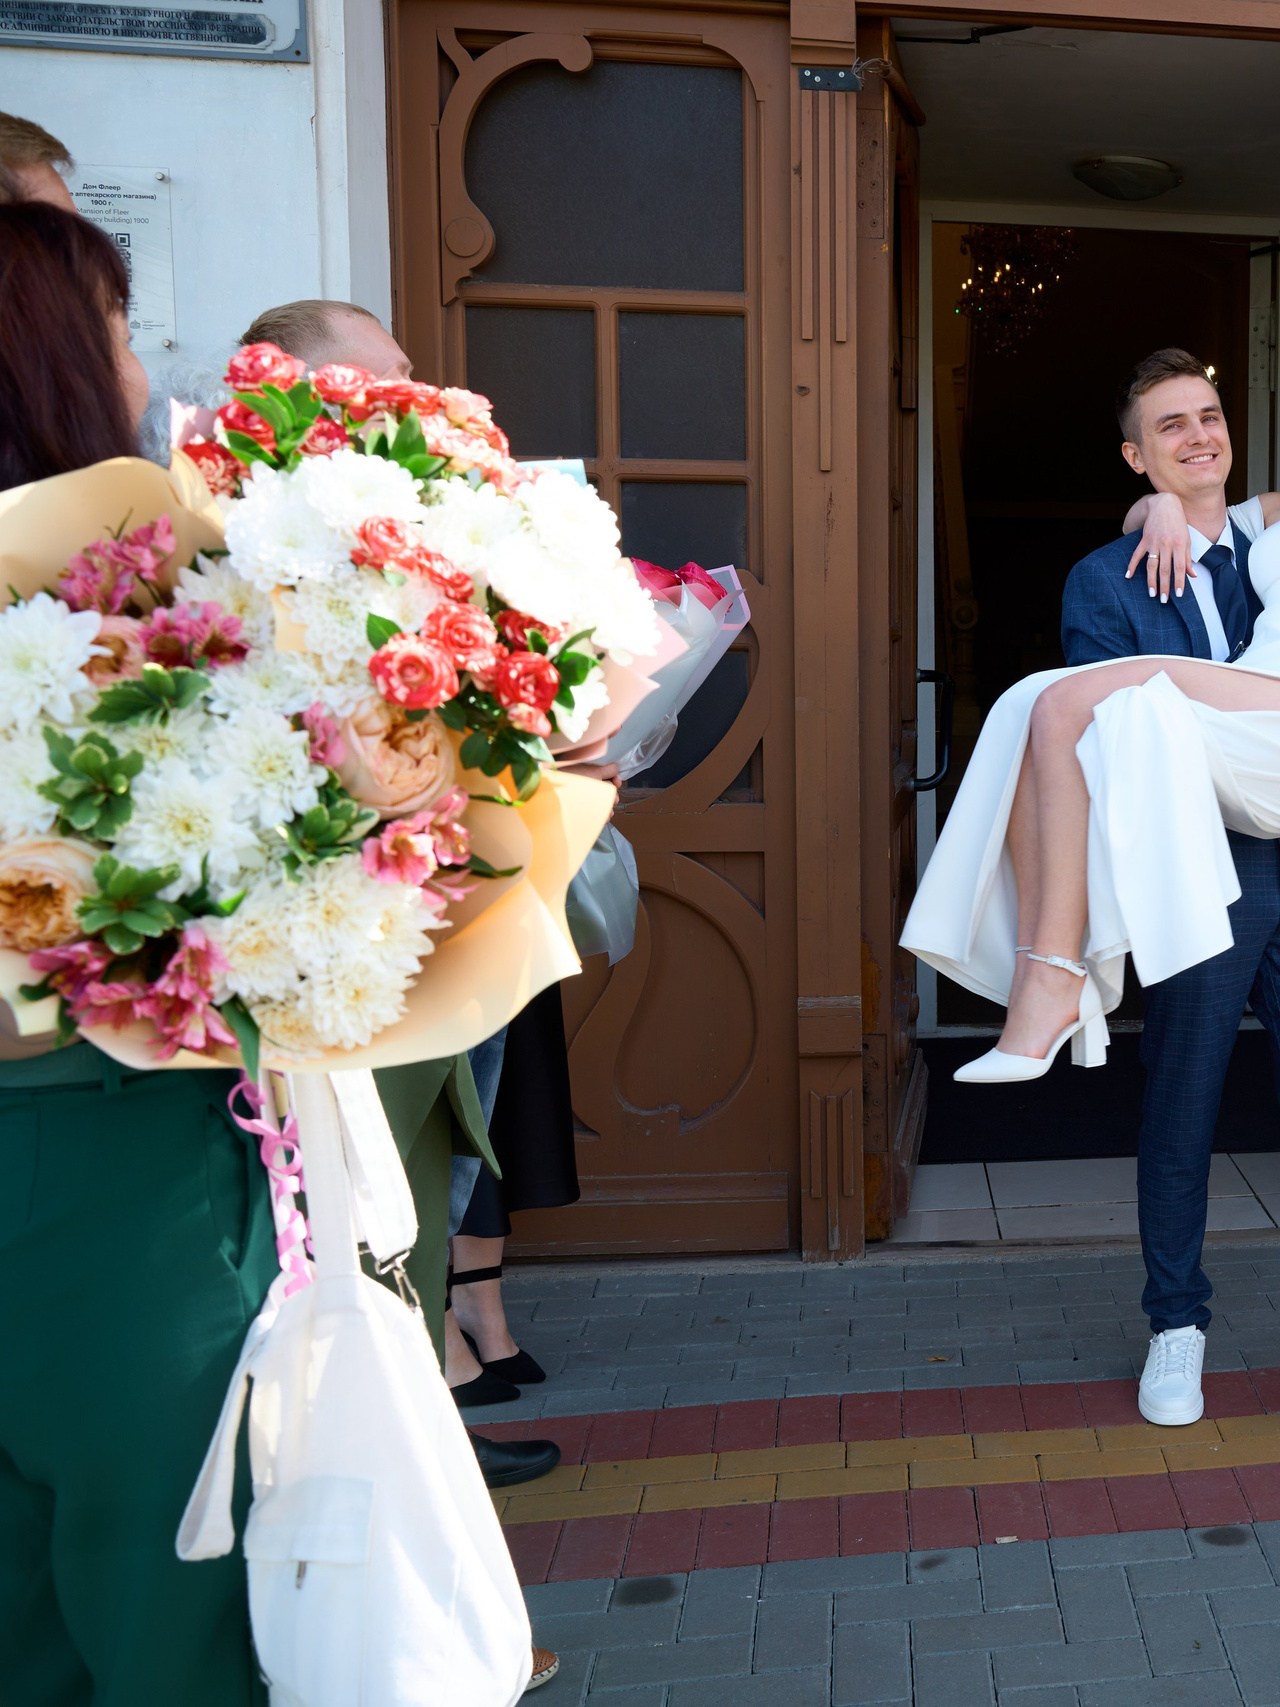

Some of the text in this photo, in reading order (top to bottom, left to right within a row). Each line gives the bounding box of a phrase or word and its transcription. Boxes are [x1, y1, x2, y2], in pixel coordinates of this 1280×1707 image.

[121, 8, 182, 19] КУЛЬТУРНОГО
[12, 22, 110, 36] АДМИНИСТРАТИВНУЮ
[46, 14, 145, 27] ЗАКОНОДАТЕЛЬСТВОМ
[147, 20, 207, 31] РОССИЙСКОЙ
